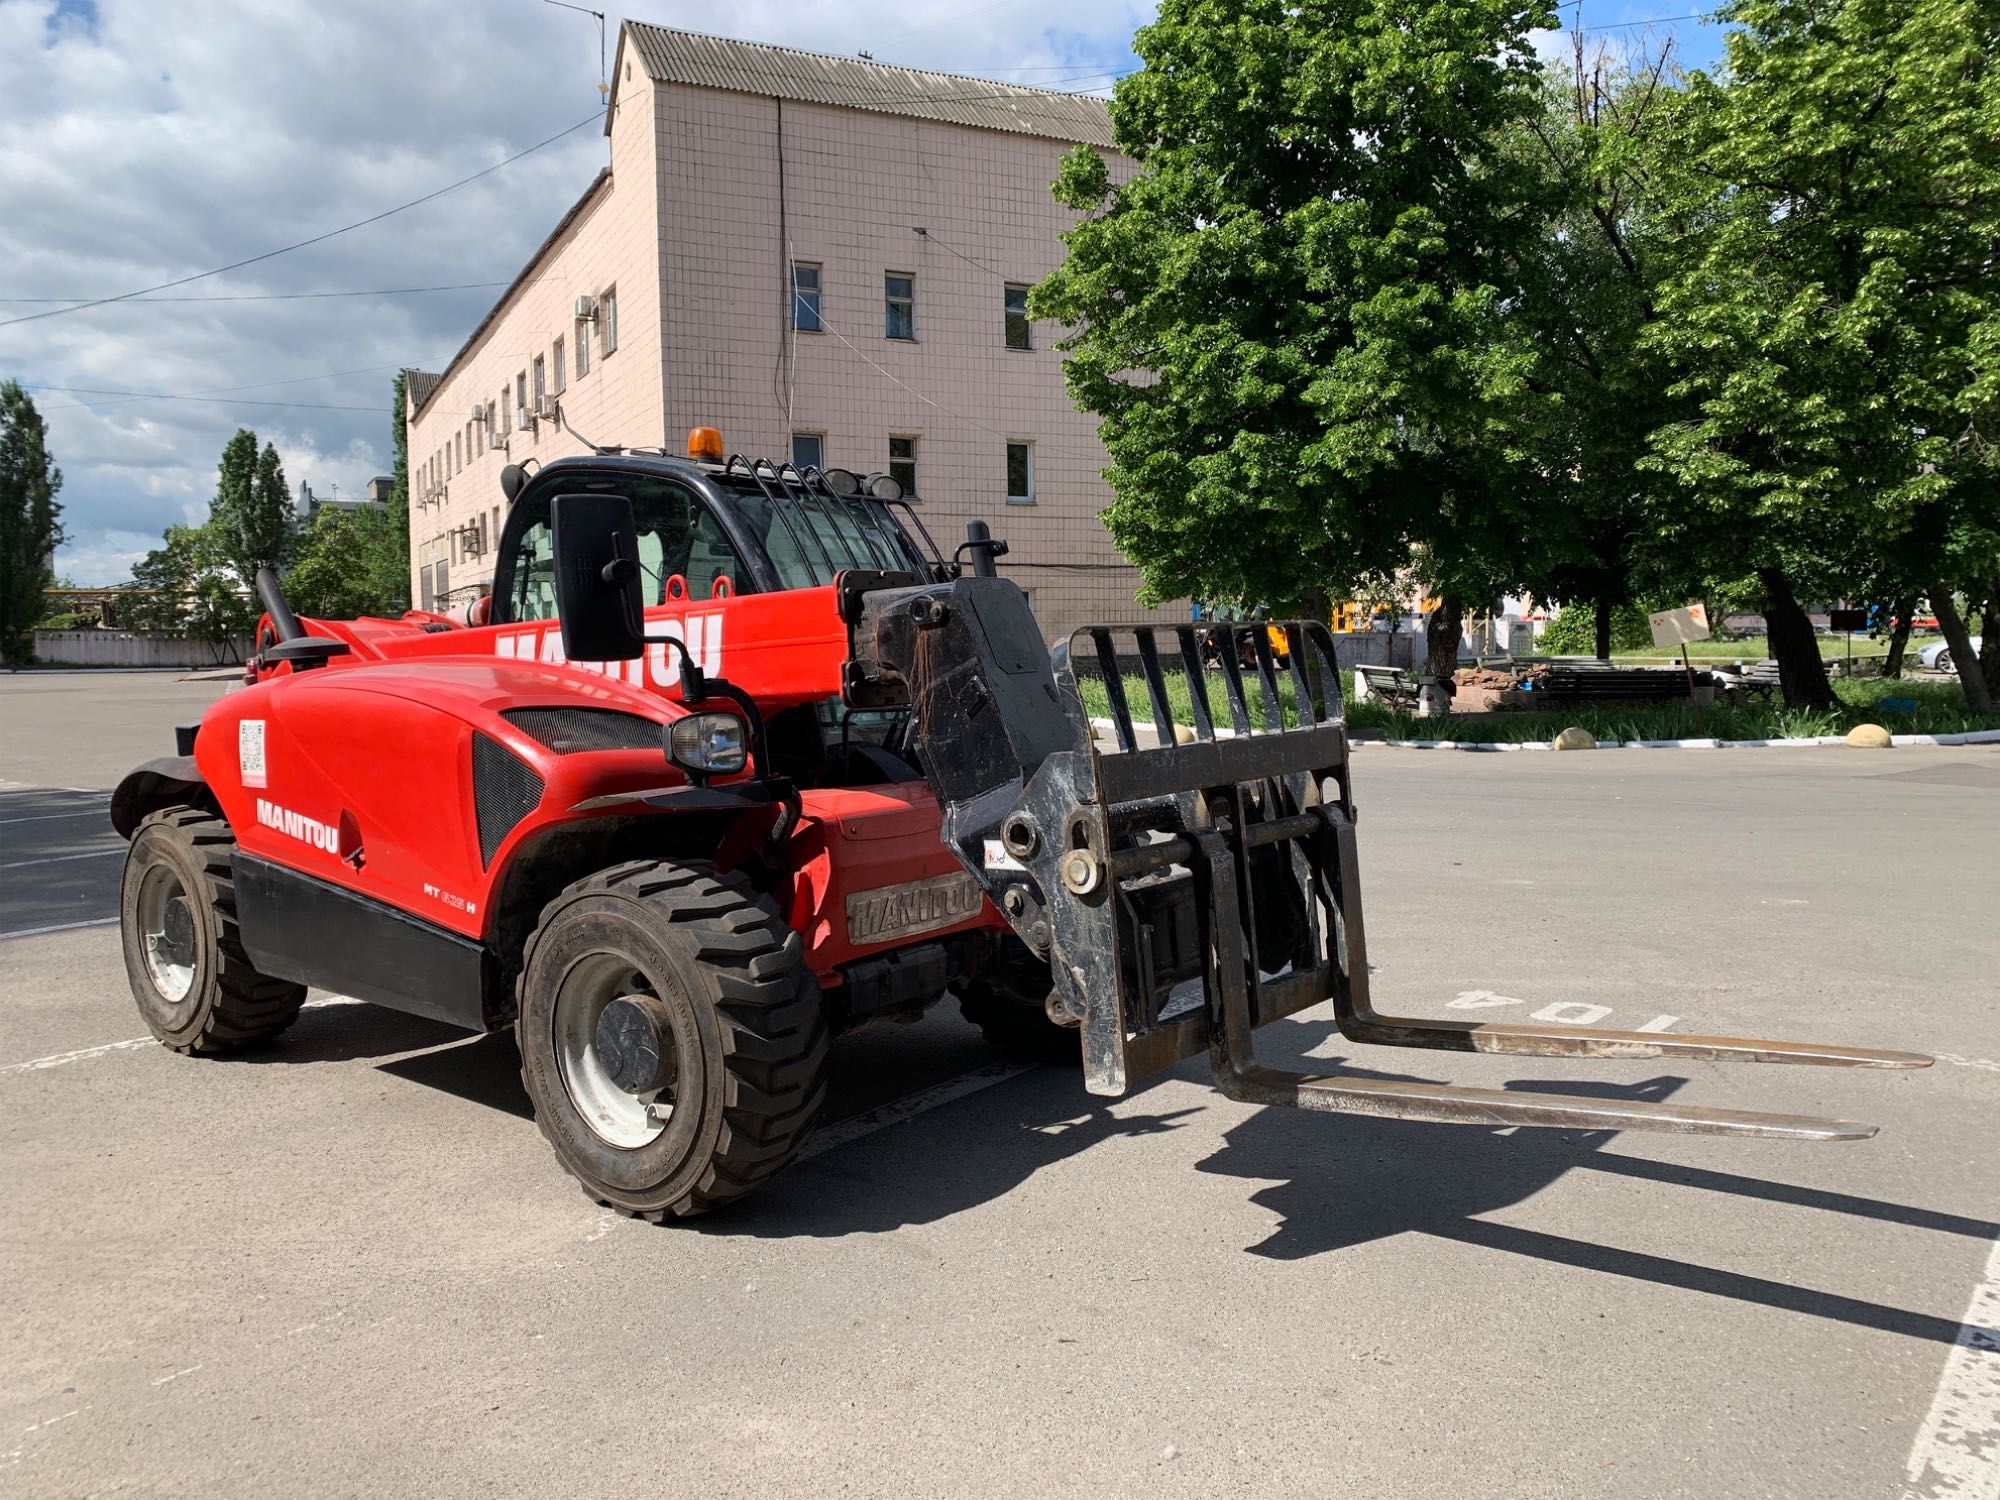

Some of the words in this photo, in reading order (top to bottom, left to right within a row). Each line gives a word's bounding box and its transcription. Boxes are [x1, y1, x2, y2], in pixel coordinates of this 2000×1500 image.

[256, 797, 339, 854] MANITOU
[423, 882, 441, 899] MT
[466, 901, 477, 915] H
[851, 879, 978, 939] MANITOU
